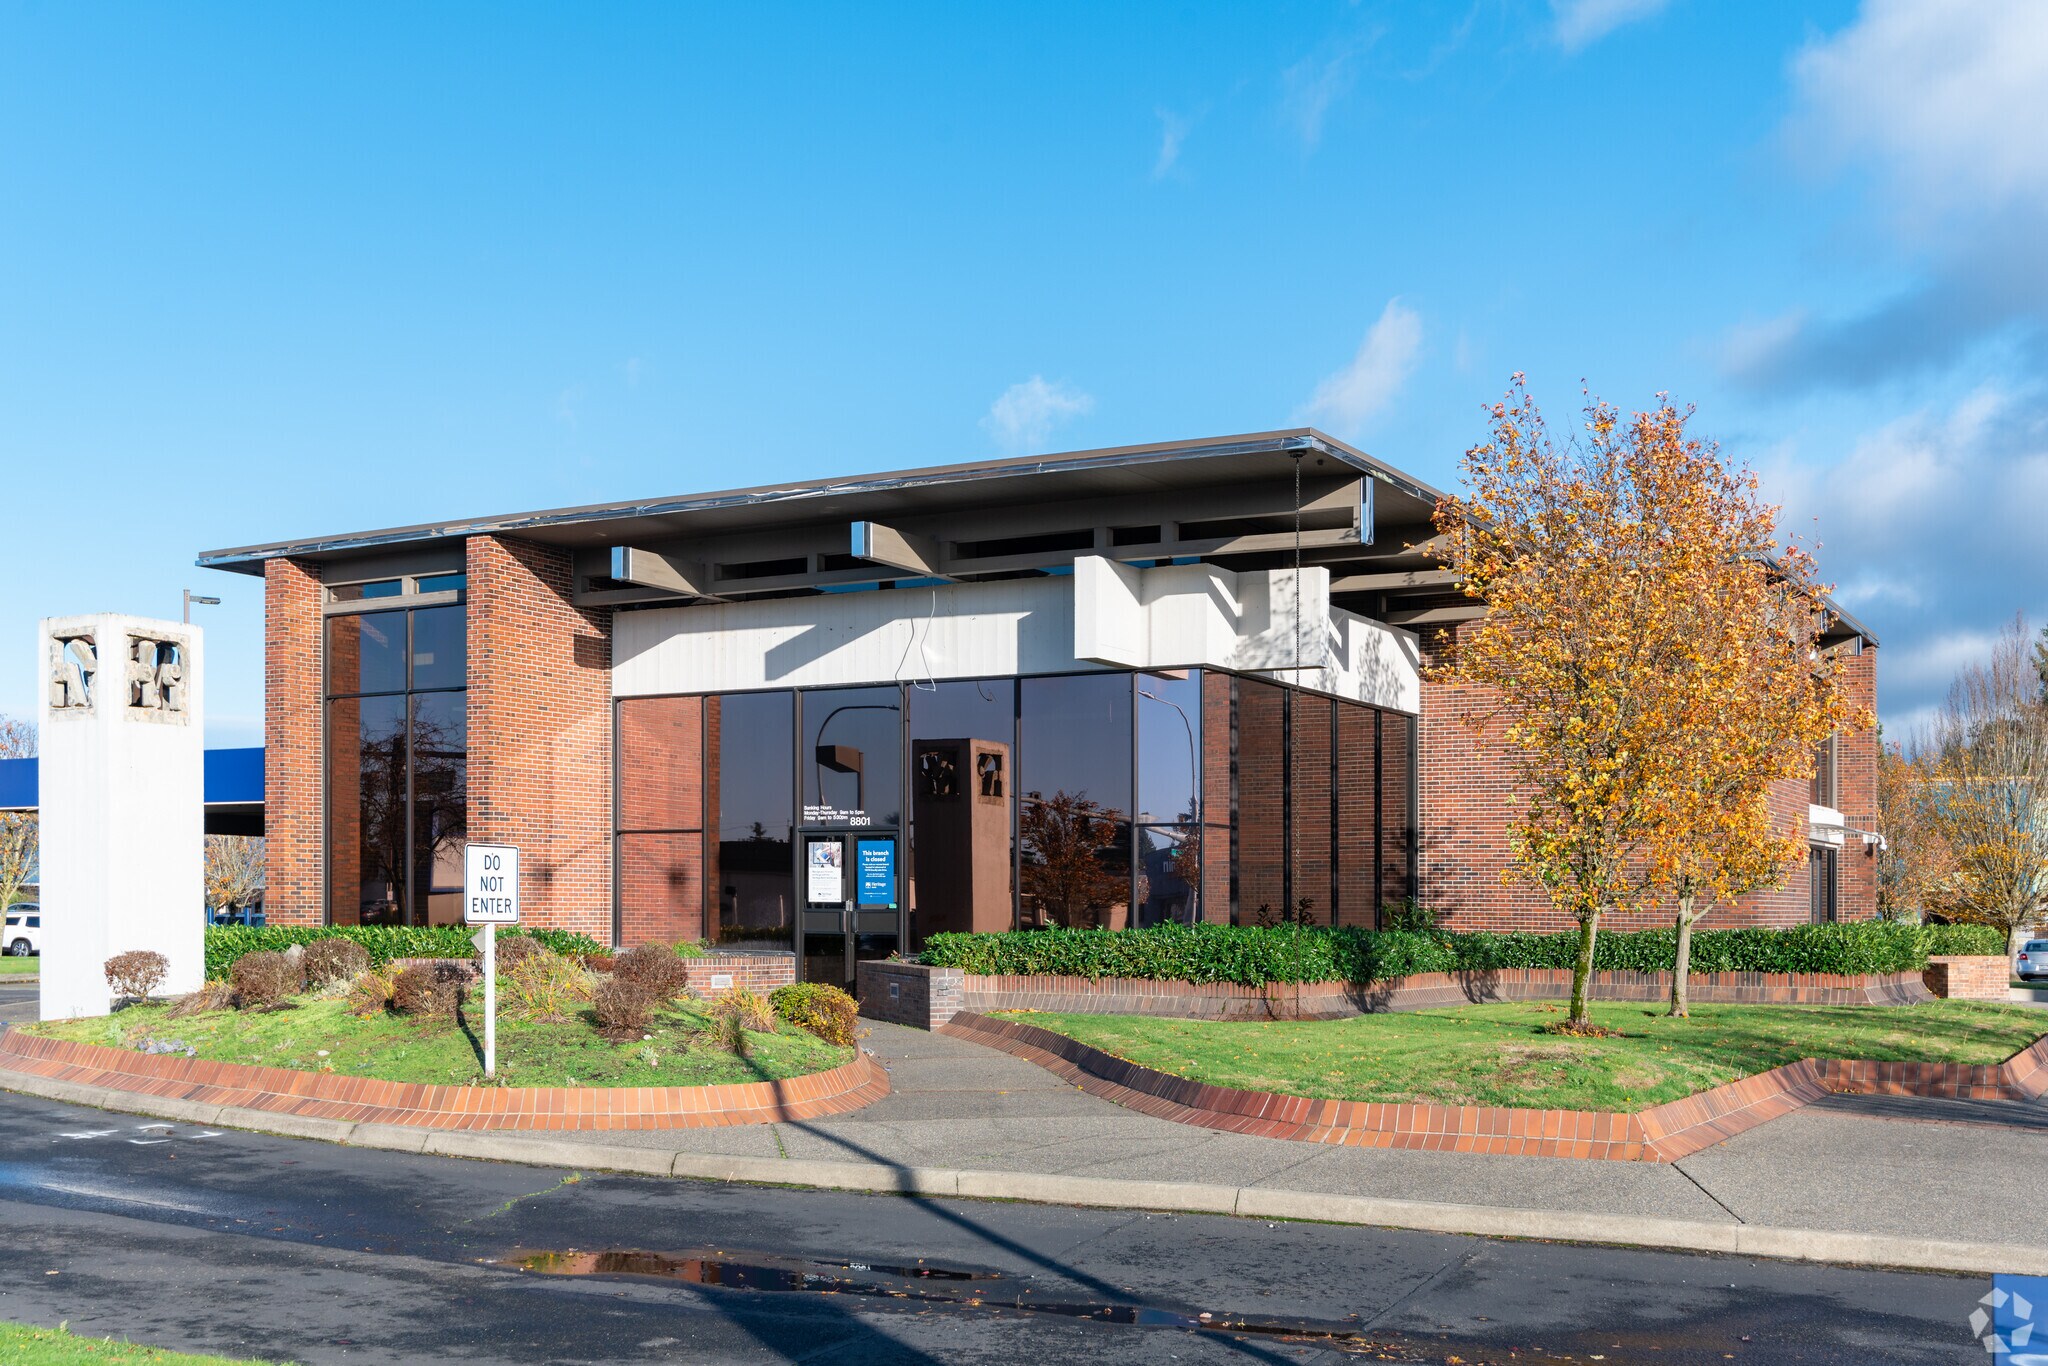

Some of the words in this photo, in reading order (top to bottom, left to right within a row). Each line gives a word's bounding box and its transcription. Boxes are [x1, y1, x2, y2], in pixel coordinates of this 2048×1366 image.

[850, 817, 870, 826] 8801
[484, 855, 500, 870] DO
[480, 876, 504, 892] NOT
[472, 898, 512, 914] ENTER
